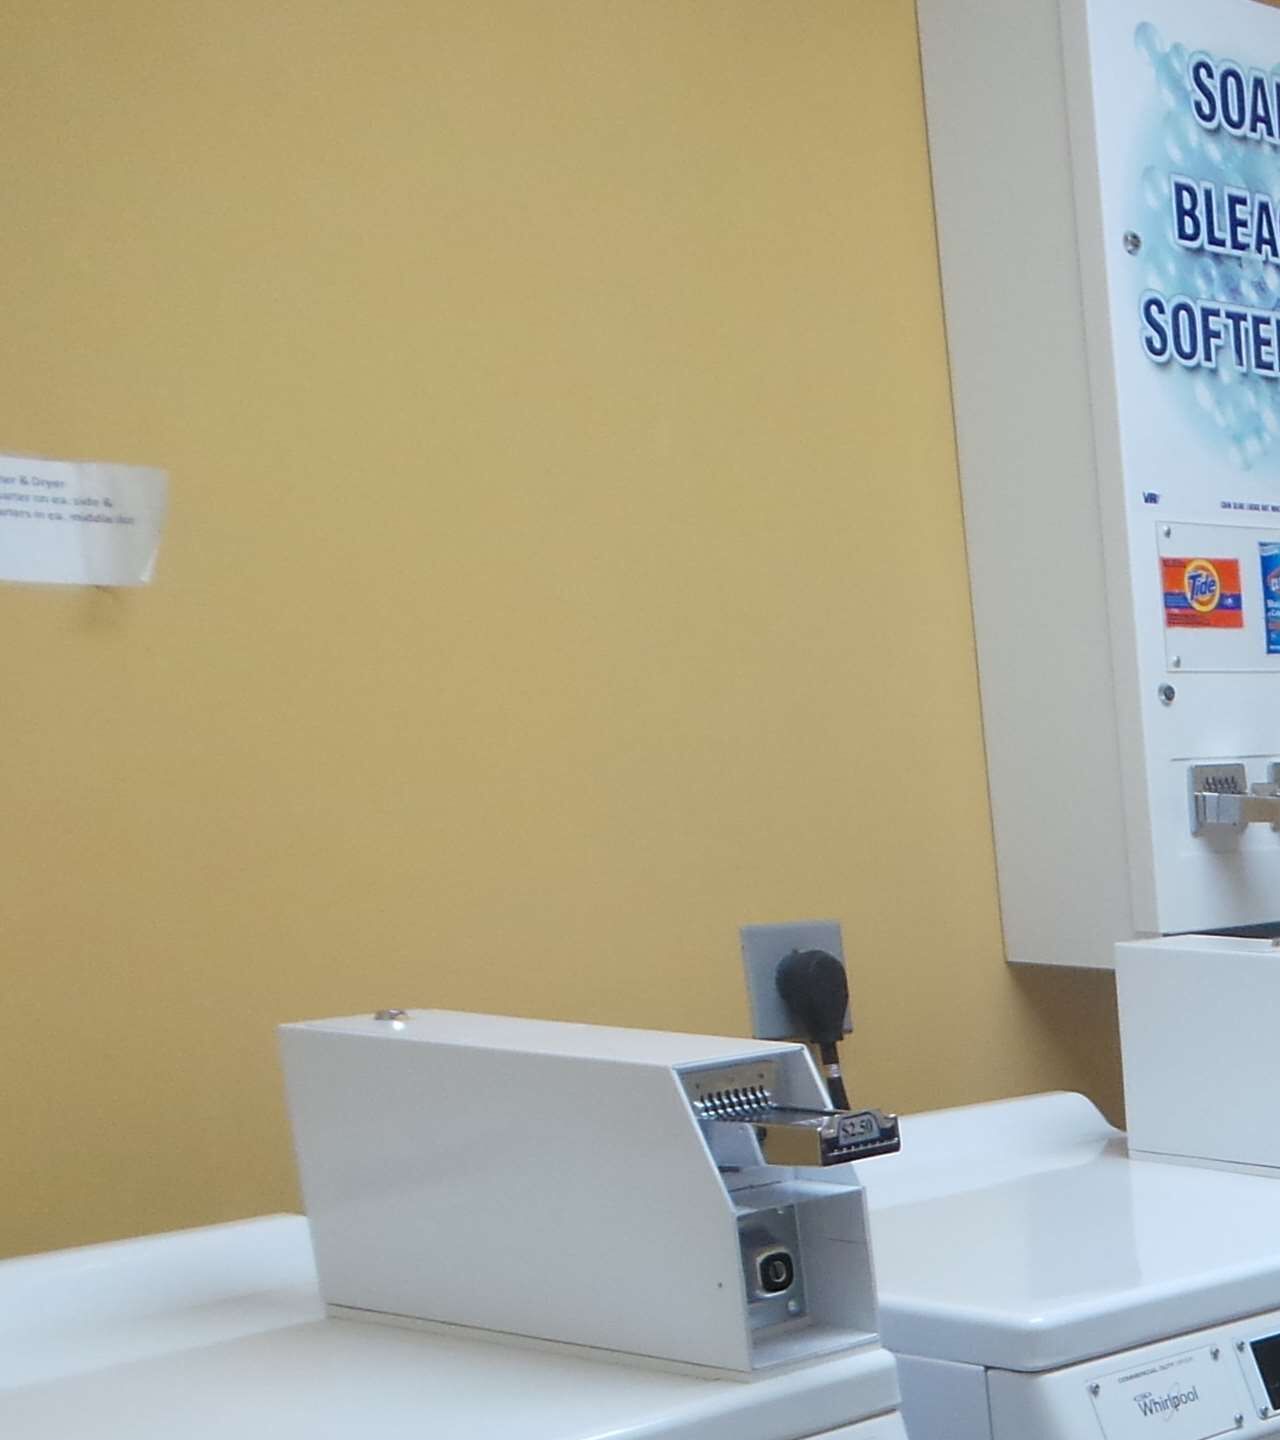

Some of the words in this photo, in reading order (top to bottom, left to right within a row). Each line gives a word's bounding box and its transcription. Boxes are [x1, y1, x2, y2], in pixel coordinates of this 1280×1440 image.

[1188, 572, 1217, 601] Tide
[840, 1118, 873, 1140] $2.50
[1137, 1385, 1199, 1417] Whirlpool
